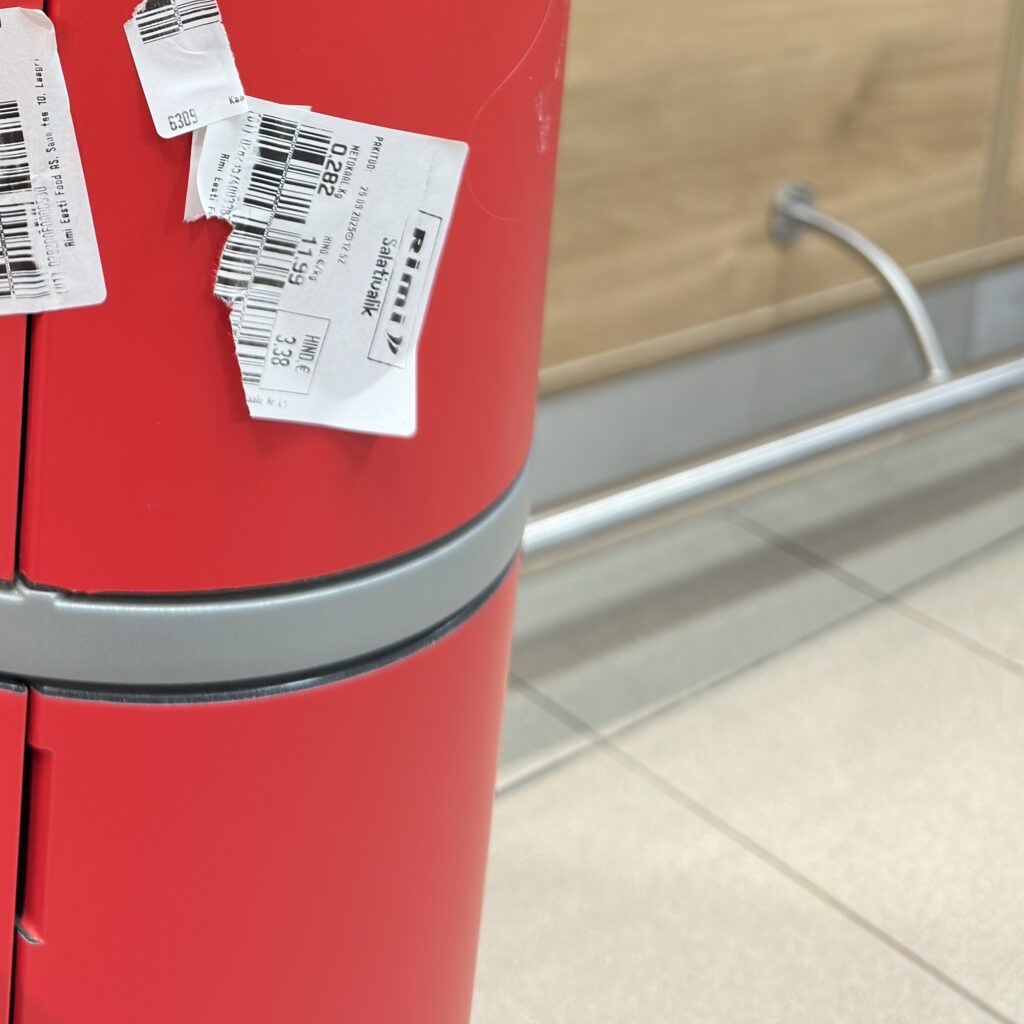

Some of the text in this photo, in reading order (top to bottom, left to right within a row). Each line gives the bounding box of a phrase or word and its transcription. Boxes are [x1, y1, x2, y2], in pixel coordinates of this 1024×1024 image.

[168, 109, 197, 133] 6309
[47, 156, 61, 170] AS,
[217, 153, 231, 172] Rimi
[317, 142, 347, 196] 0,282
[51, 174, 65, 196] Food
[57, 197, 71, 224] Eesti
[64, 226, 75, 247] Rimi
[288, 234, 316, 285] 11,99
[361, 238, 395, 316] Salativalik
[391, 228, 425, 323] Rimi
[271, 335, 296, 366] 3,38
[296, 335, 320, 373] HIND,€
